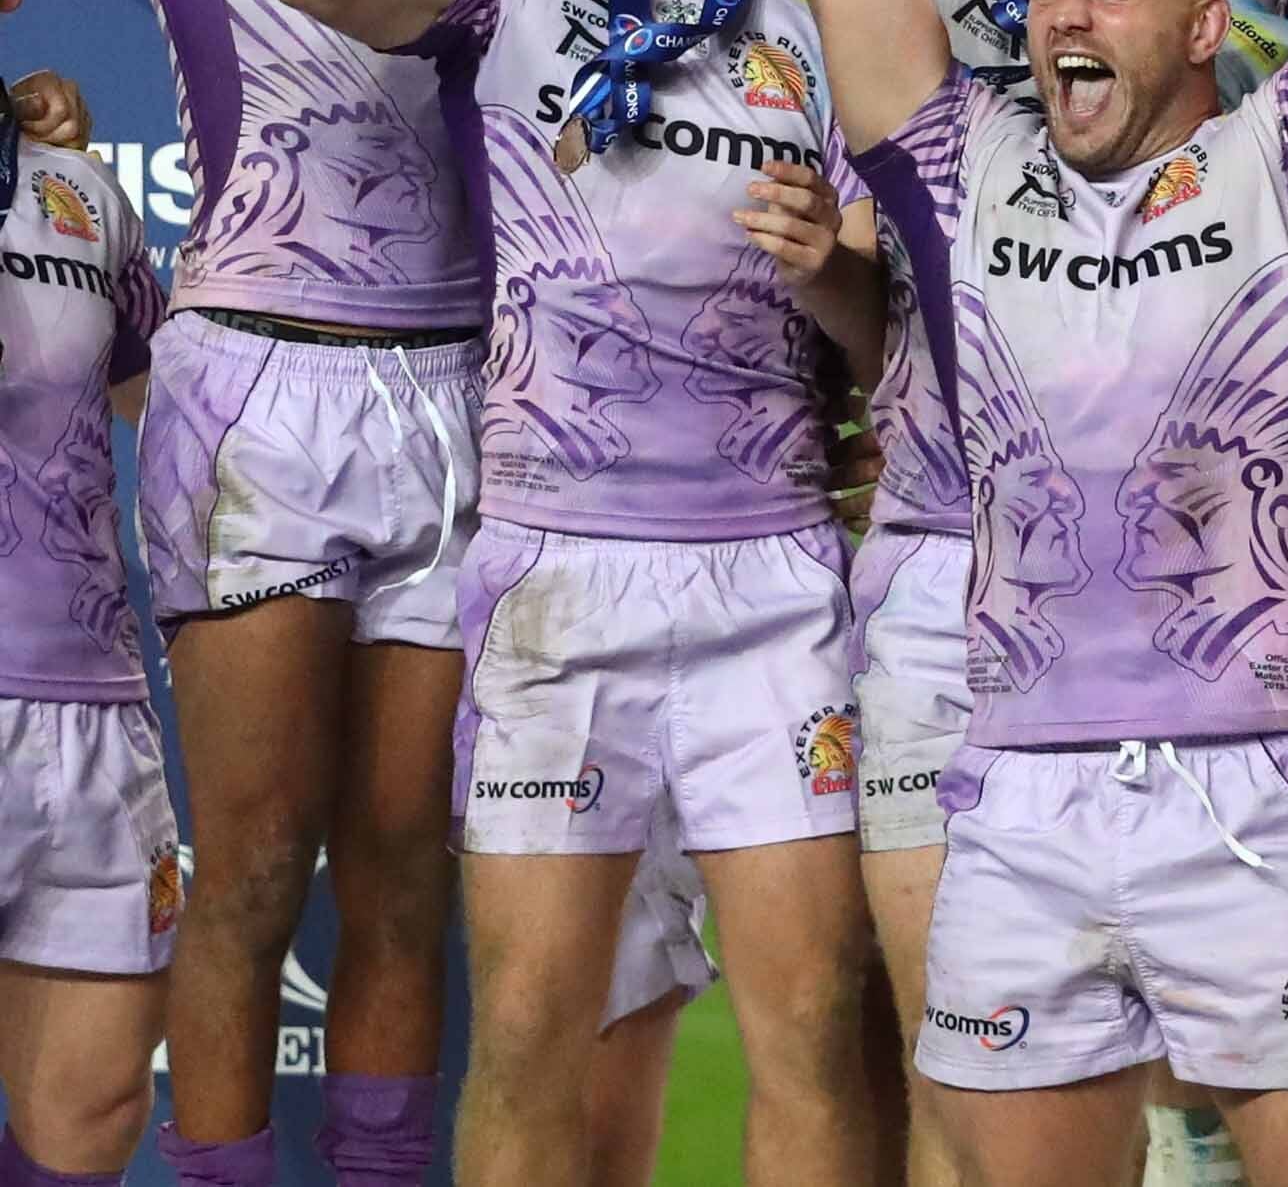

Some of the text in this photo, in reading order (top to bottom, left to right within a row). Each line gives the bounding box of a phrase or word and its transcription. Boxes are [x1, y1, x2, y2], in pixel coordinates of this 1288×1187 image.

[777, 36, 819, 105] RUGBY
[0, 251, 115, 300] omms
[795, 704, 835, 779] EXETER
